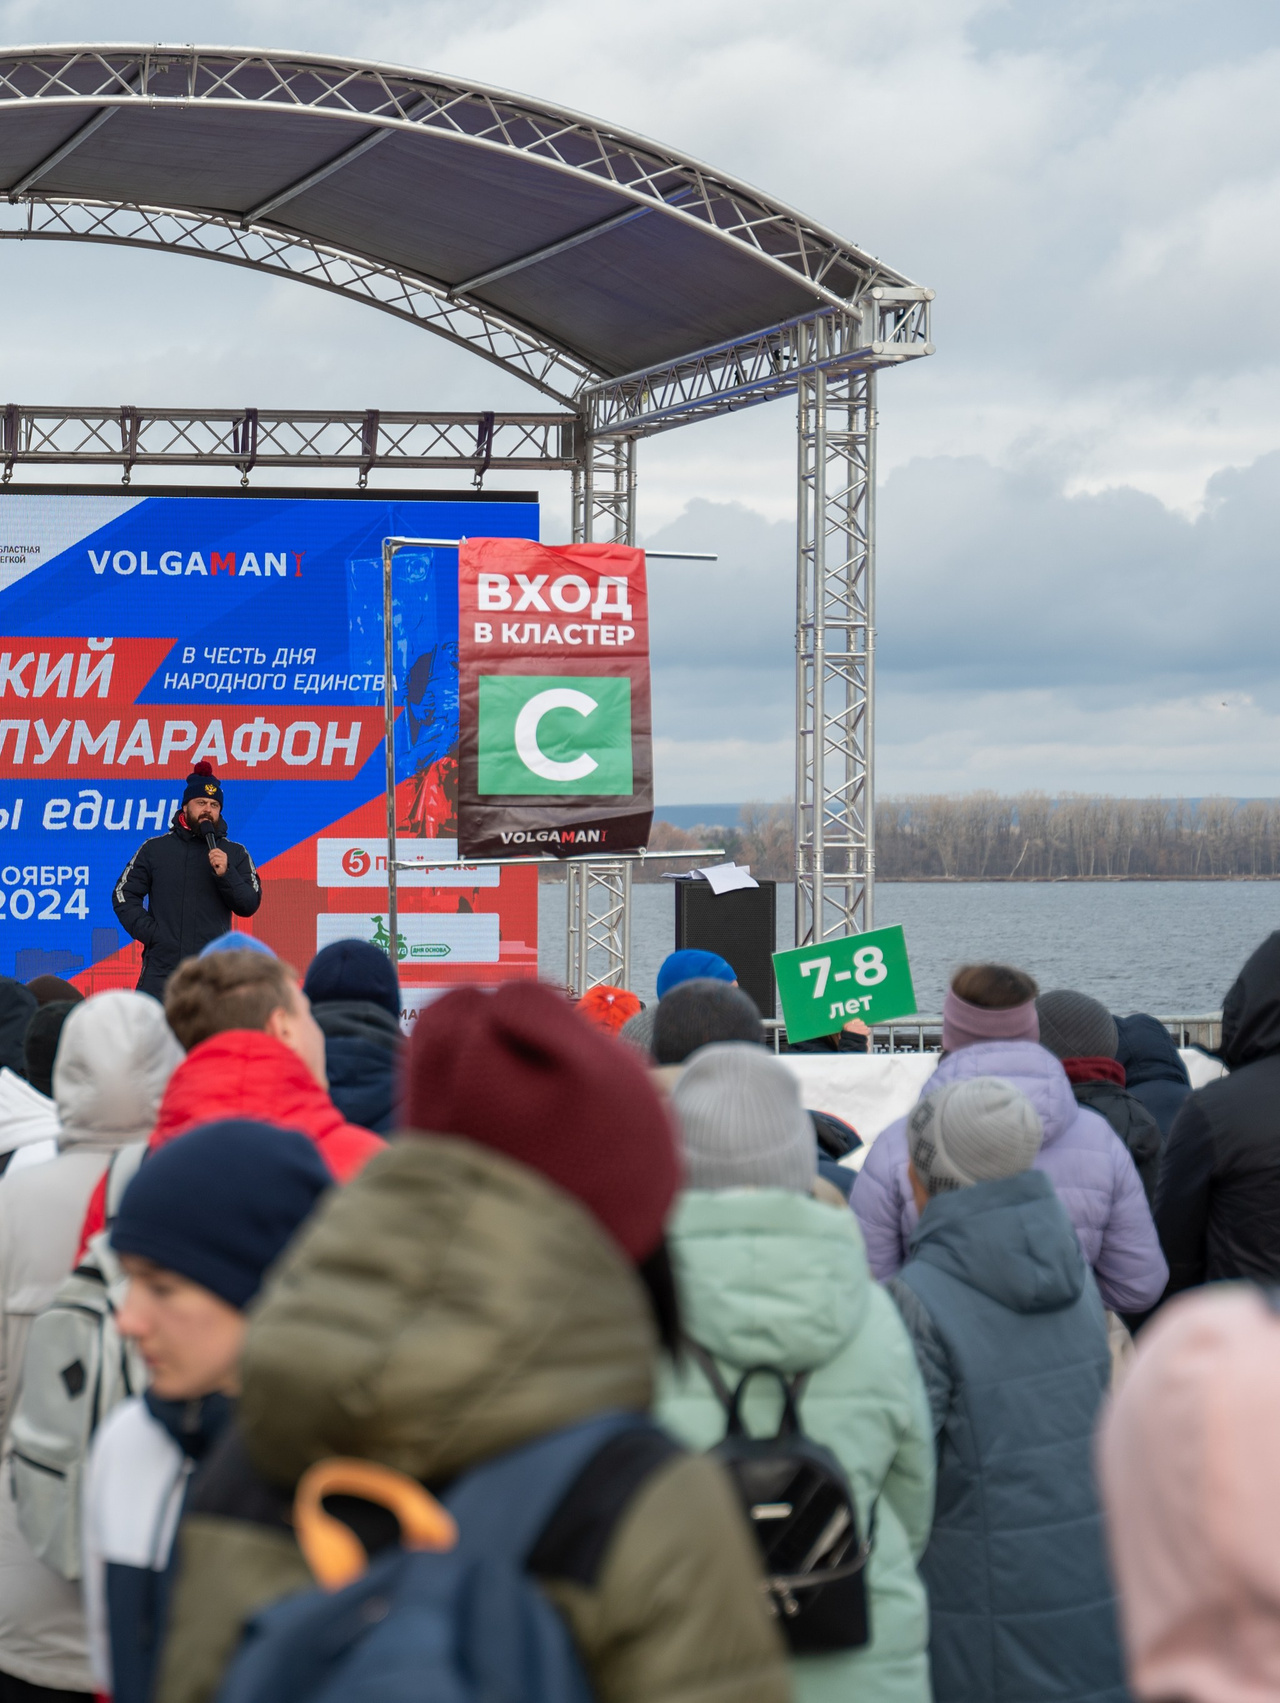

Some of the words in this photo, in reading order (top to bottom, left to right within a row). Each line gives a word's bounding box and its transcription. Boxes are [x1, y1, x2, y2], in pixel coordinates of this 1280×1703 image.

[477, 572, 633, 621] ВХОД
[474, 622, 493, 643] В
[501, 622, 635, 646] КЛАСТЕР
[182, 647, 196, 664] В
[204, 647, 267, 664] ЧЕСТЬ
[272, 648, 317, 668] ДНЯ
[163, 672, 287, 694] НАРОДНОГО
[514, 688, 599, 782] C
[799, 946, 888, 999] 7-8
[829, 995, 873, 1019] лет
